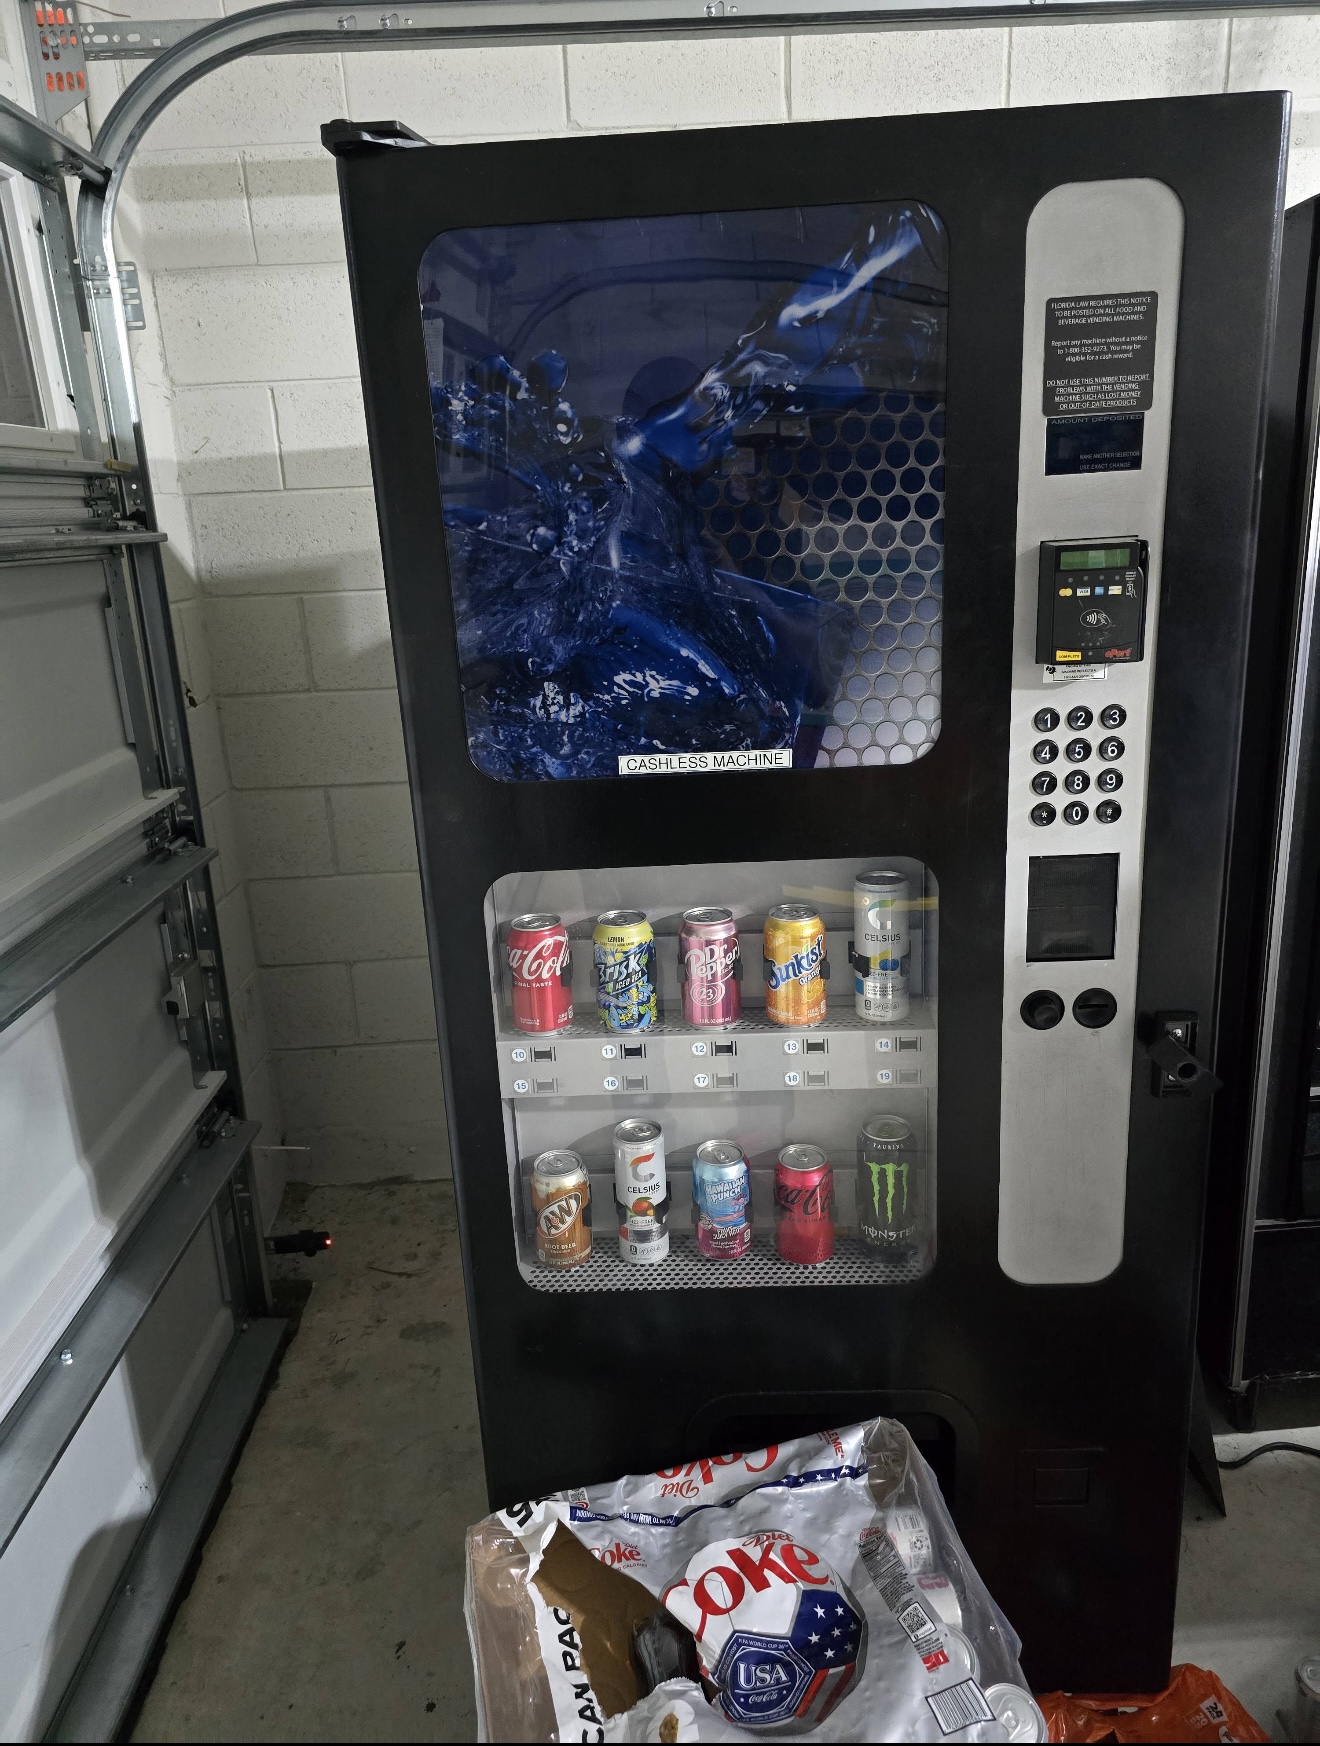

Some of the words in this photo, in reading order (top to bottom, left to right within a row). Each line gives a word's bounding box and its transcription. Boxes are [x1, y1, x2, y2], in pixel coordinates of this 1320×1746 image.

[1052, 301, 1075, 309] FLORIDA
[1076, 300, 1089, 308] LAW
[1090, 299, 1116, 307] REQUIRES
[1131, 296, 1151, 304] NOTICE
[1058, 317, 1087, 325] BEVERAGE
[1087, 316, 1113, 324] VENDING
[1081, 337, 1105, 345] machine
[1065, 355, 1086, 363] eligible
[1127, 373, 1150, 381] REPORT
[1054, 394, 1081, 402] MACHINE
[1120, 390, 1141, 398] MONEY
[1056, 386, 1086, 394] PROBLEMS
[1107, 398, 1137, 406] PRODUCTS
[1051, 417, 1089, 425] AMOUNT
[1092, 414, 1143, 423] DEPOSITED
[1115, 450, 1140, 458] SELECTION
[1091, 462, 1108, 470] EXACT
[1109, 461, 1131, 469] CHANGE
[1044, 713, 1051, 728] 1
[1077, 711, 1086, 726] 2
[1109, 709, 1120, 725] 3
[1041, 745, 1051, 760] 4
[1074, 744, 1084, 759] 5
[1107, 742, 1118, 757] 6
[626, 755, 709, 771] CASHLESS
[713, 752, 784, 768] MACHINE
[1041, 777, 1050, 792] 7
[1073, 775, 1083, 790] 8
[1106, 773, 1116, 789] 9
[1072, 806, 1082, 821] 0
[864, 932, 901, 943] CELSIUS
[507, 934, 570, 981] a-Cola
[704, 943, 728, 963] Dr
[684, 944, 739, 981] Pepper
[767, 935, 824, 991] Sunkist
[615, 978, 631, 990] ICED
[631, 971, 643, 983] TEA
[799, 966, 821, 986] Orang
[532, 980, 553, 988] TASTE
[699, 987, 714, 1001] 23
[694, 1045, 705, 1053] 12
[786, 1043, 797, 1051] 13
[696, 1076, 707, 1084] 17
[879, 1072, 890, 1080] 19
[627, 1181, 661, 1194] CELSIUS
[704, 1175, 745, 1195] HAWAIIAN
[710, 1186, 741, 1203] PUNCH
[775, 1174, 832, 1216] ca-Co
[860, 1222, 917, 1241] MONSTER
[661, 1479, 700, 1499] Diet
[622, 1541, 639, 1550] Diet
[742, 1531, 794, 1549] Diet
[557, 1606, 582, 1671] PAC
[738, 1638, 749, 1646] FIFA
[749, 1640, 767, 1648] WORLD
[736, 1661, 790, 1689] USA
[748, 1689, 779, 1705] Coca-Cola
